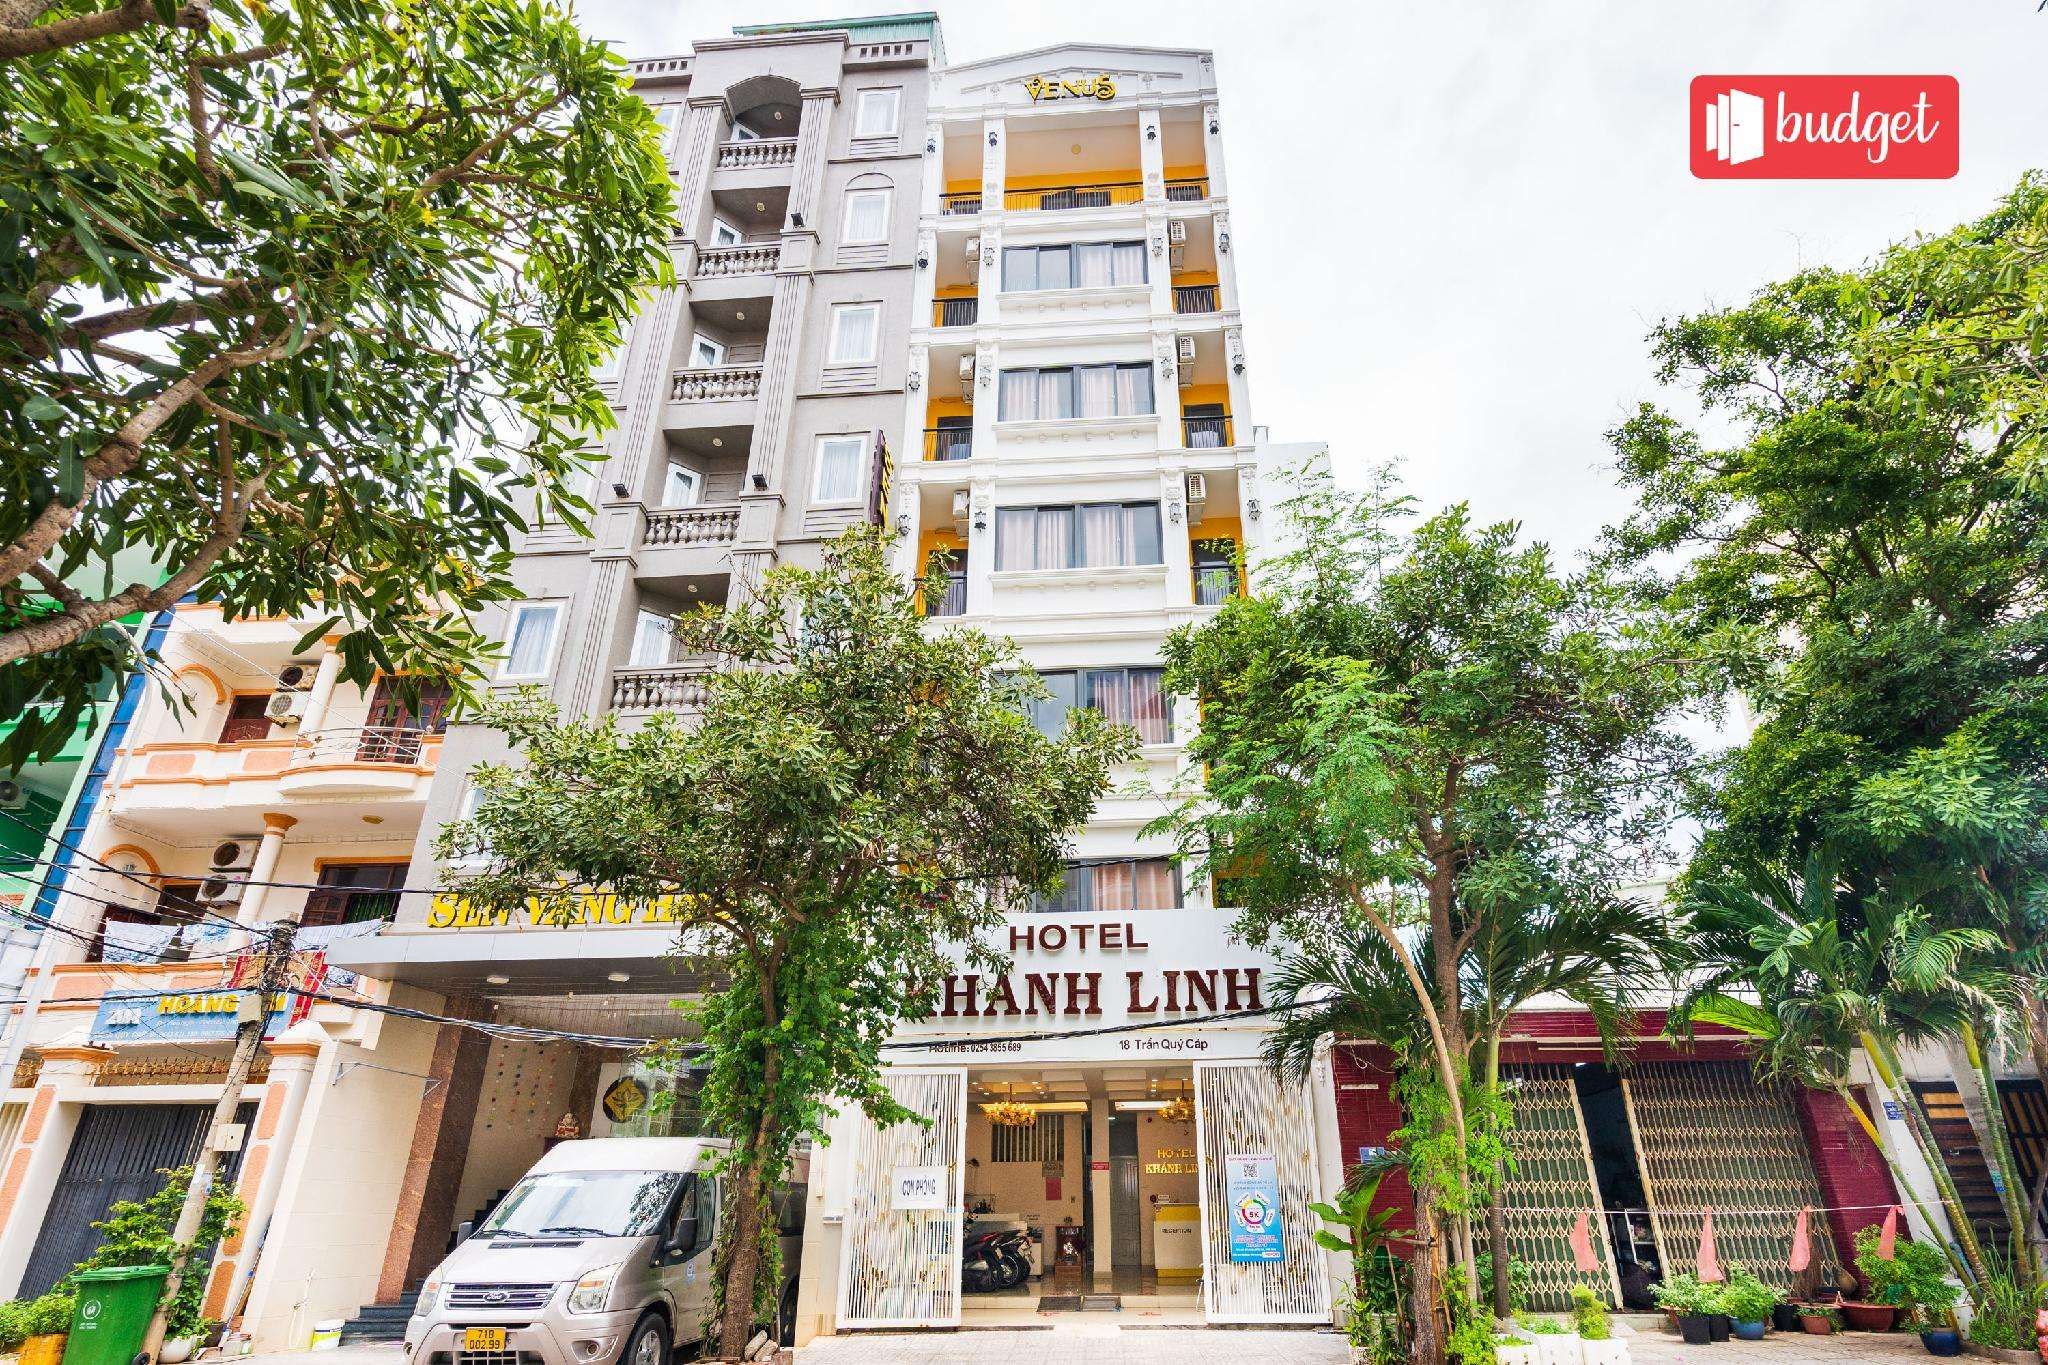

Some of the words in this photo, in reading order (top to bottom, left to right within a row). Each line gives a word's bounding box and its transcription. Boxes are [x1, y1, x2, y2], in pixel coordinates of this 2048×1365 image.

[1024, 73, 1116, 103] VENUS
[1009, 922, 1149, 951] HOTEL
[1126, 967, 1264, 1014] LINH
[1007, 1042, 1021, 1052] 689
[1119, 1039, 1131, 1050] 18
[1157, 1148, 1196, 1159] HOTEL
